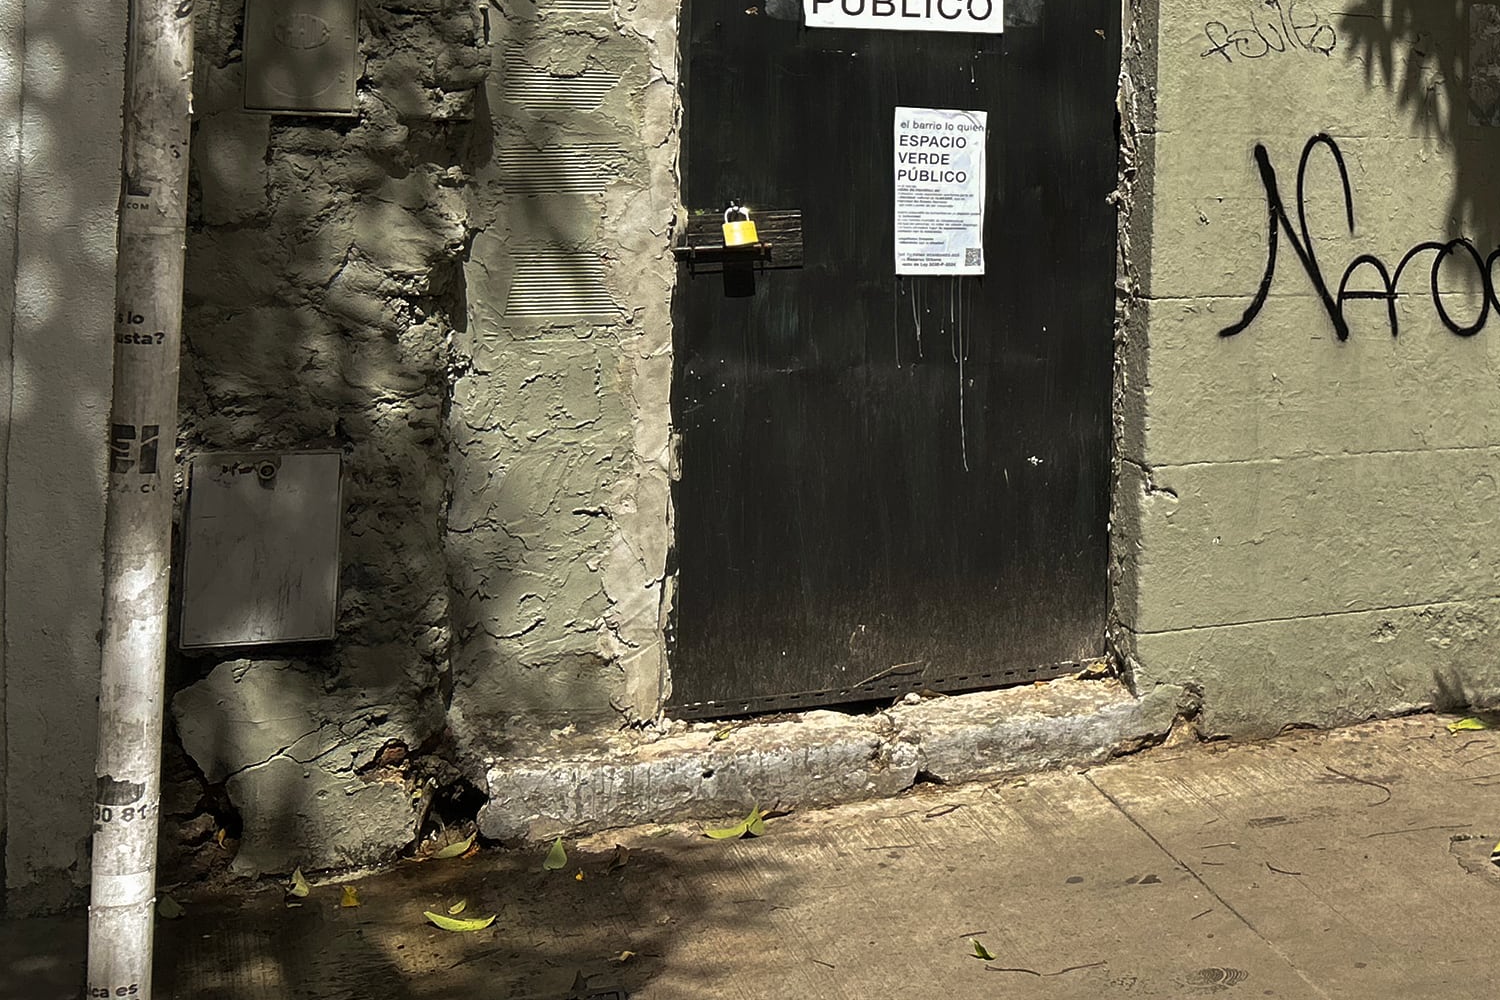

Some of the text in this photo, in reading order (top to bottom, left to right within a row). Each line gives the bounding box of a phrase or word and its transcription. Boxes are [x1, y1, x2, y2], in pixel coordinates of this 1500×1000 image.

[912, 120, 942, 131] barrio
[945, 122, 954, 131] lo
[899, 135, 967, 149] ESPACIO
[898, 152, 950, 165] VERDE
[897, 166, 967, 183] PÚBLICO
[116, 332, 165, 345] usta?
